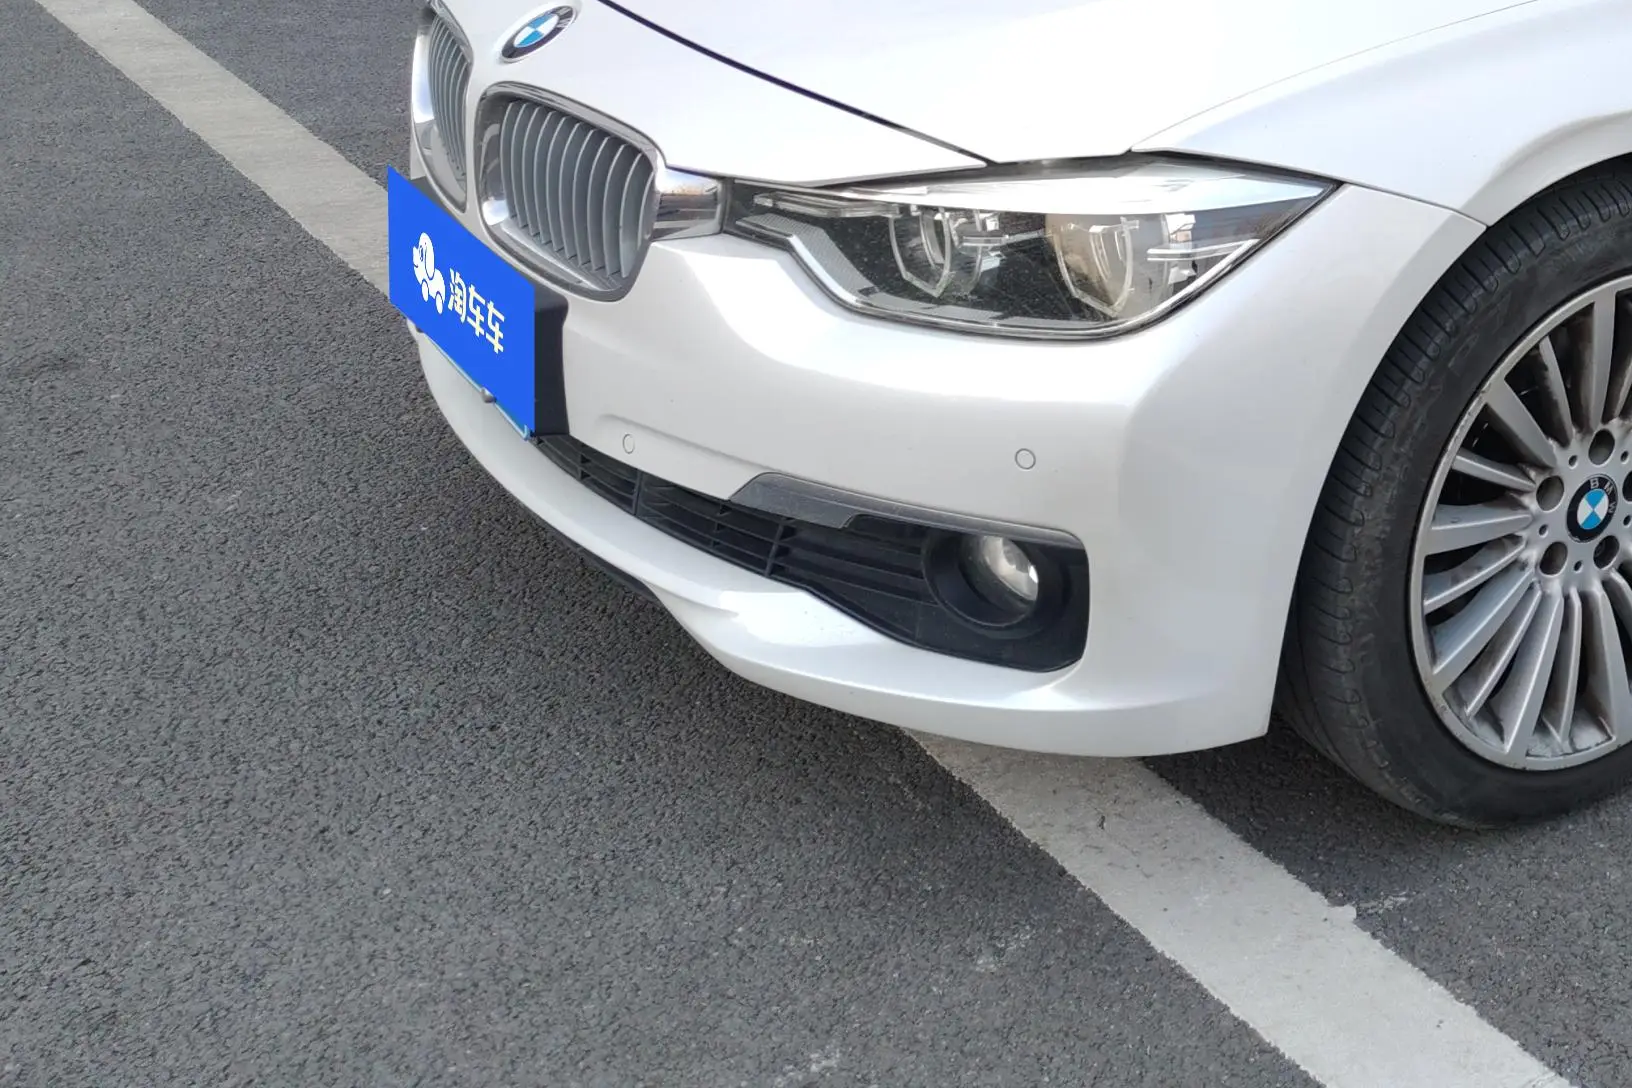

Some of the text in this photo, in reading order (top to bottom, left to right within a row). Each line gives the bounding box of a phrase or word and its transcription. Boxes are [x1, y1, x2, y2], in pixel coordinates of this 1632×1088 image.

[447, 267, 505, 354] 淘车车
[1590, 478, 1617, 514] BMW
